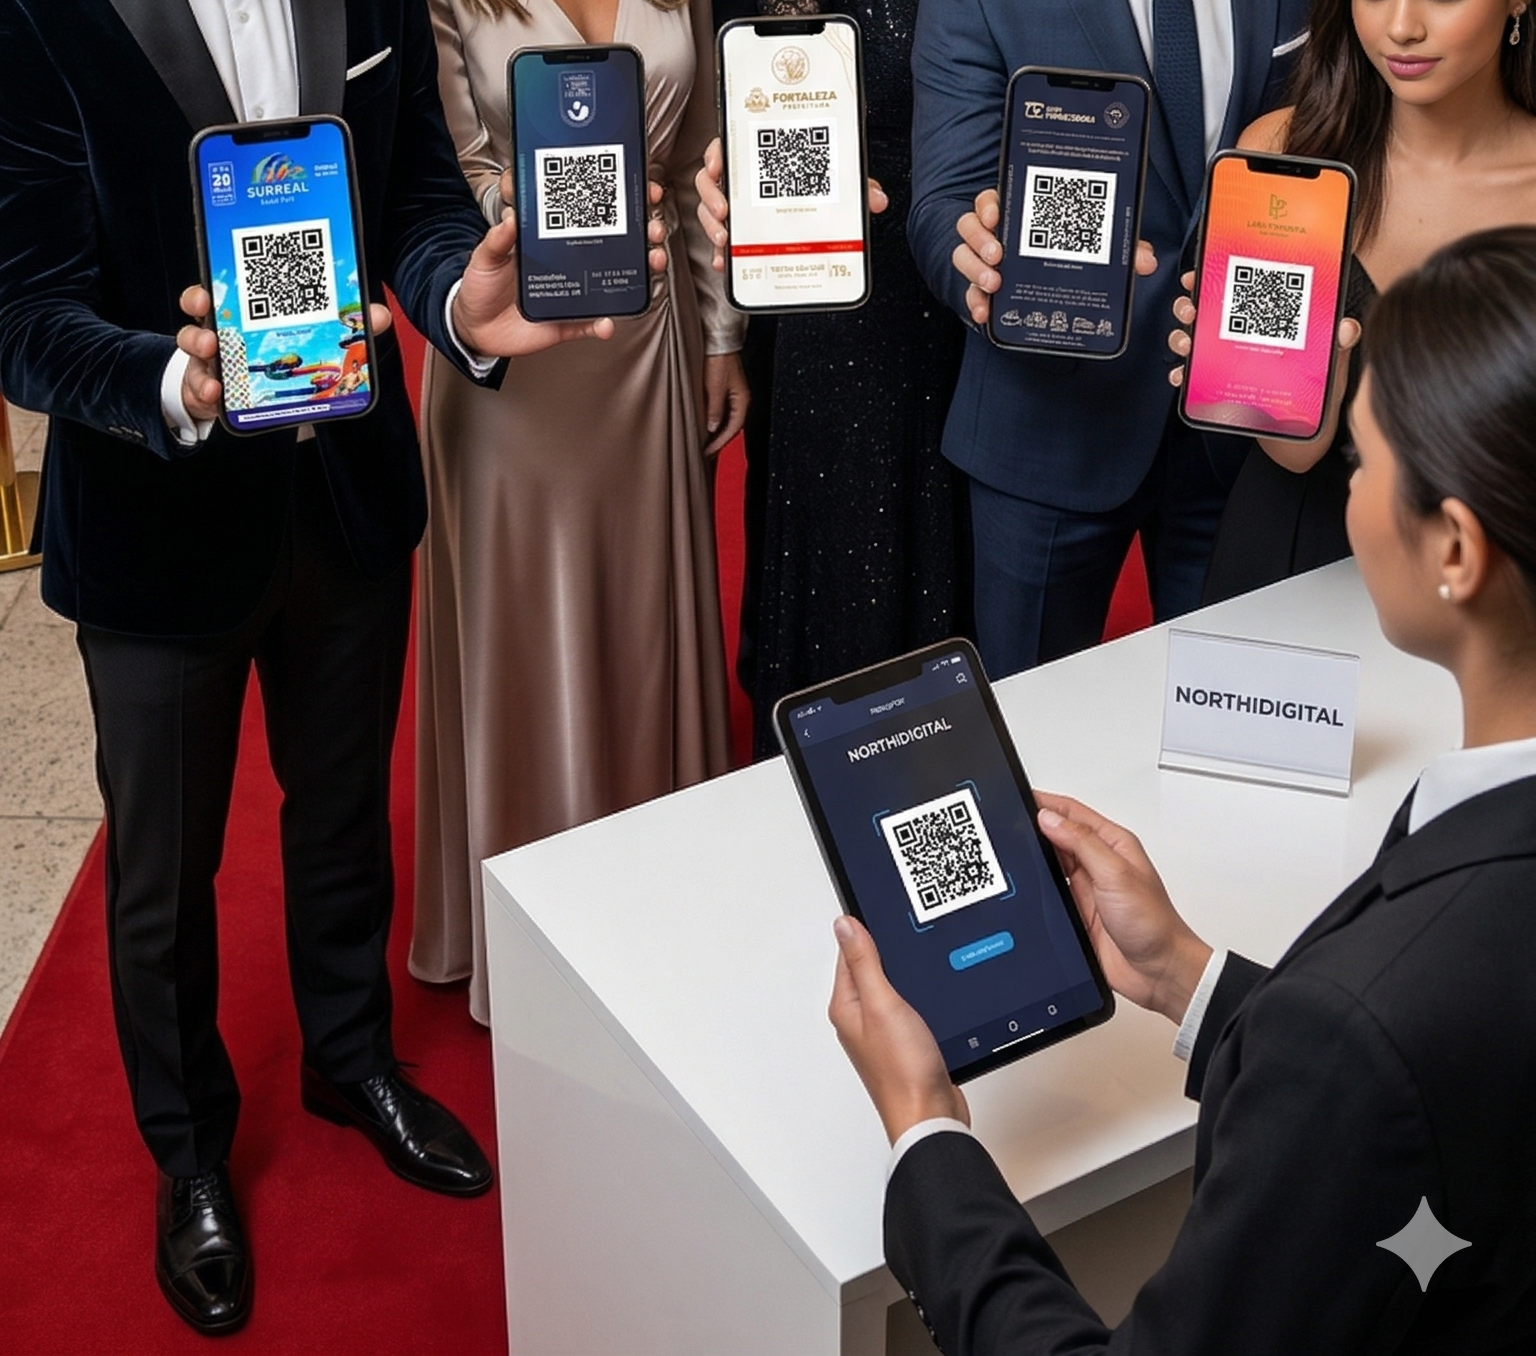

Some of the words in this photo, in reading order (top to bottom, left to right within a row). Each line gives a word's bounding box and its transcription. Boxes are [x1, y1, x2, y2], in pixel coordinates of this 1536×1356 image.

[773, 91, 837, 102] FORTALEZA
[212, 173, 231, 186] 20
[247, 182, 309, 198] SURREAL
[1175, 685, 1344, 727] NORTHIDIGITAL
[847, 717, 953, 763] NORTHIDIGITAL
